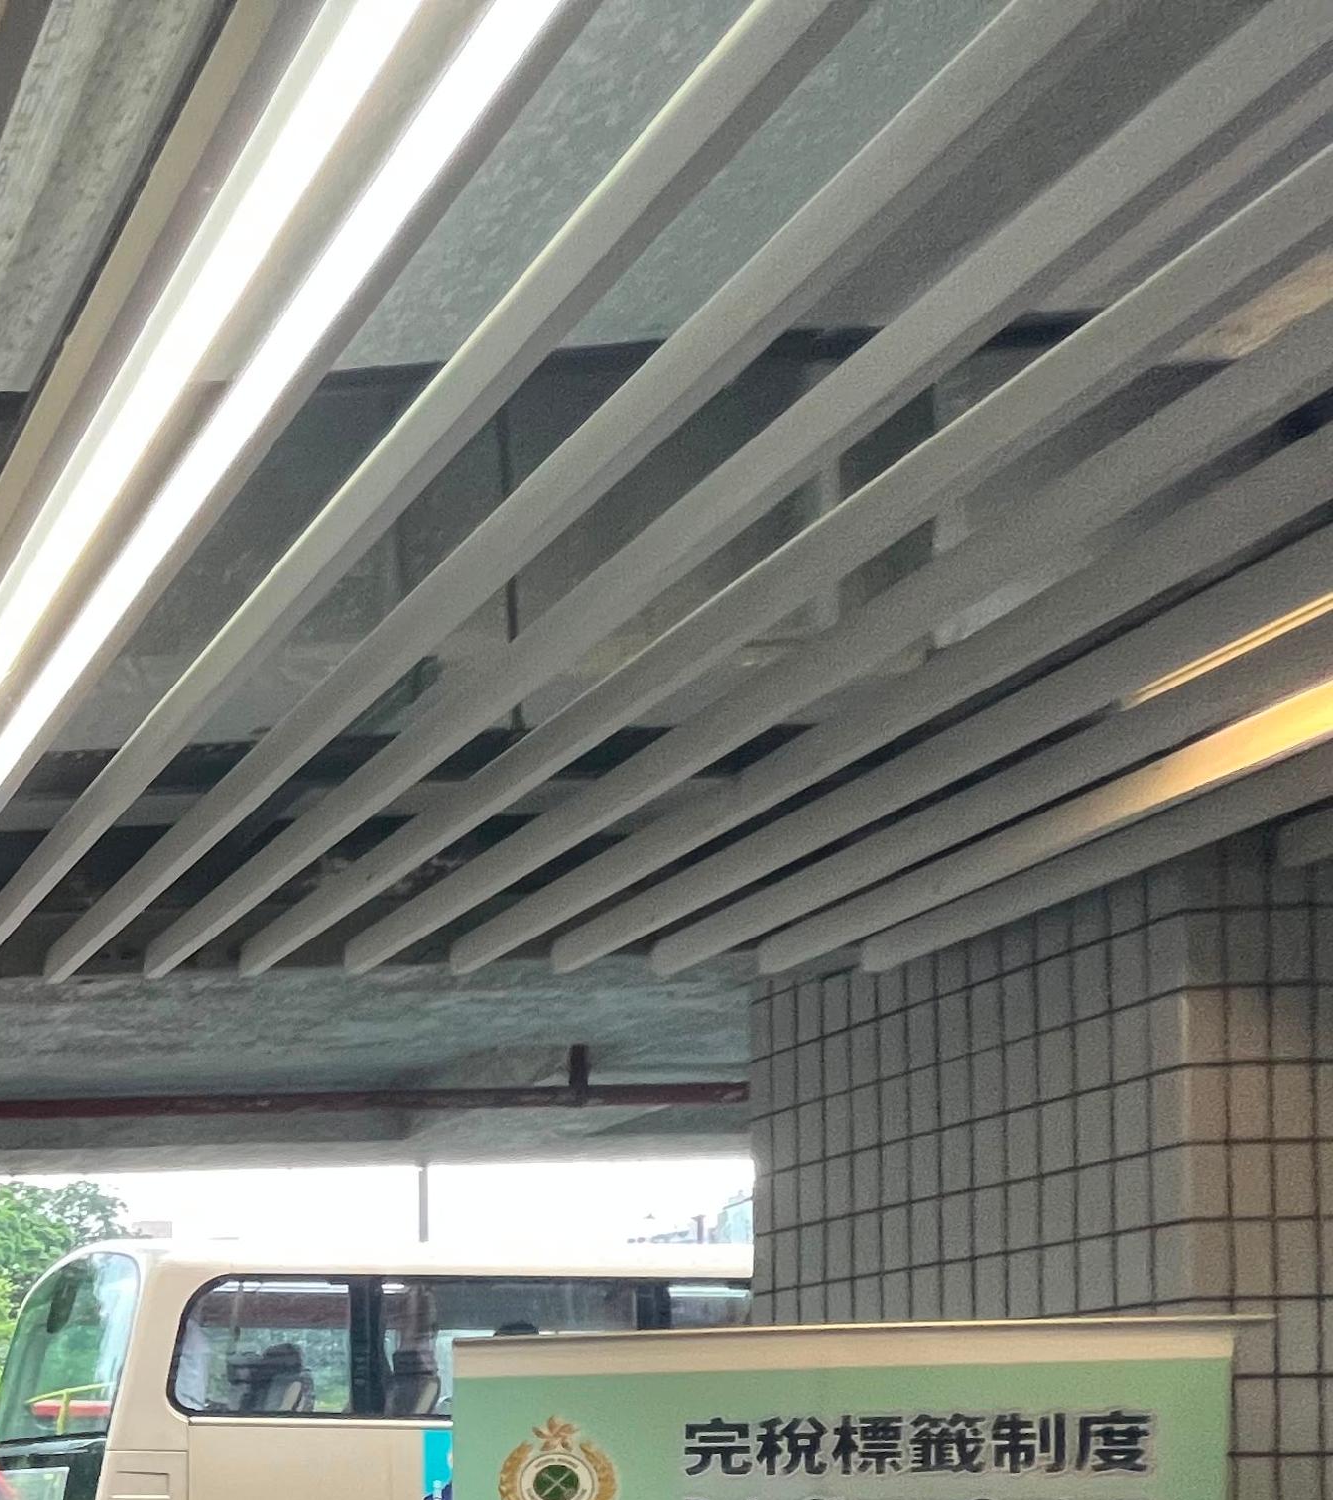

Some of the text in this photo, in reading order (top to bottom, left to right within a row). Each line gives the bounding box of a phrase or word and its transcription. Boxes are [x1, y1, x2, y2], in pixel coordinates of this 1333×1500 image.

[683, 1411, 1151, 1475] 完稅標籤制度
